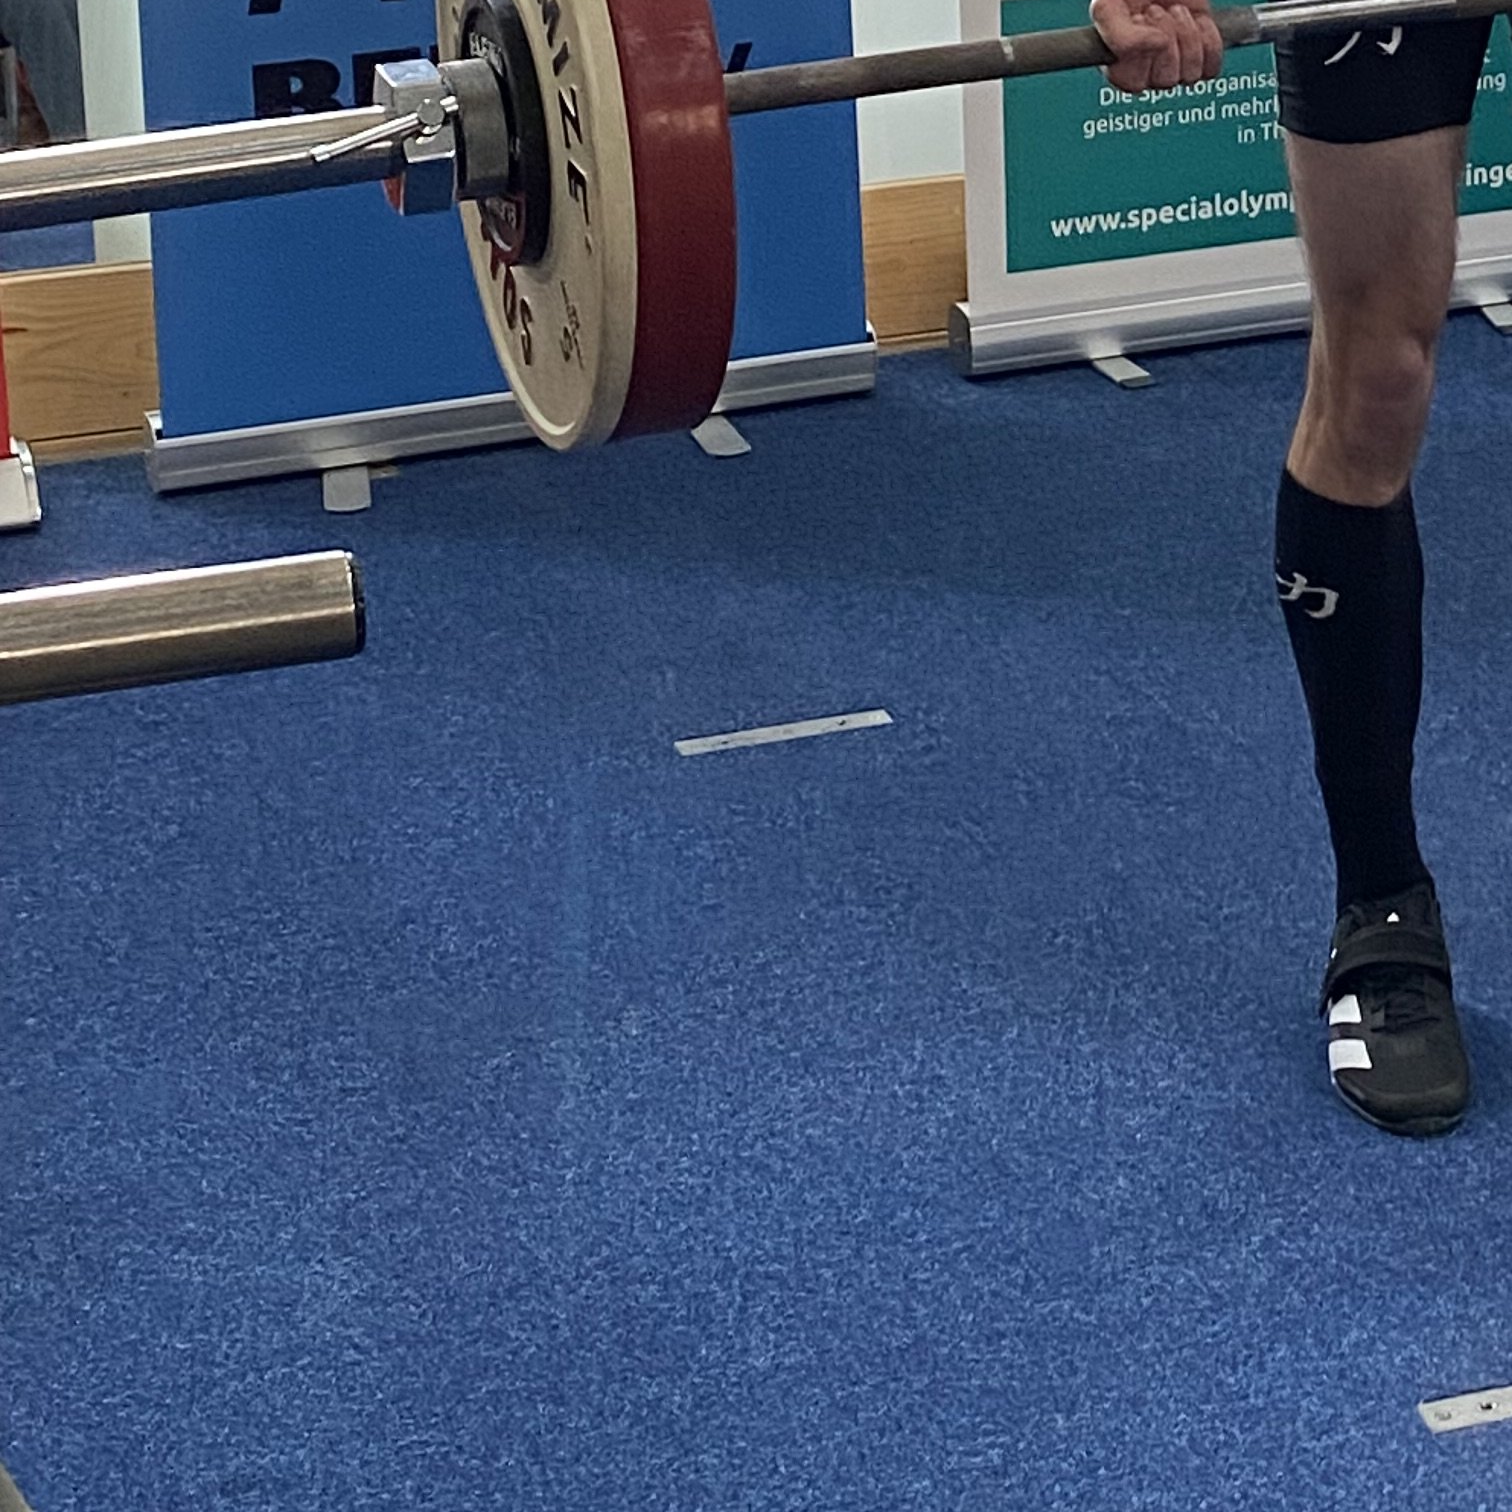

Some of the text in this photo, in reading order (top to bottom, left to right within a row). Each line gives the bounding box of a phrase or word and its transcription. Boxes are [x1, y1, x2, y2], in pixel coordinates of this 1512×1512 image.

[1083, 110, 1172, 139] geistiger
[1178, 101, 1216, 124] und
[1238, 125, 1255, 143] in
